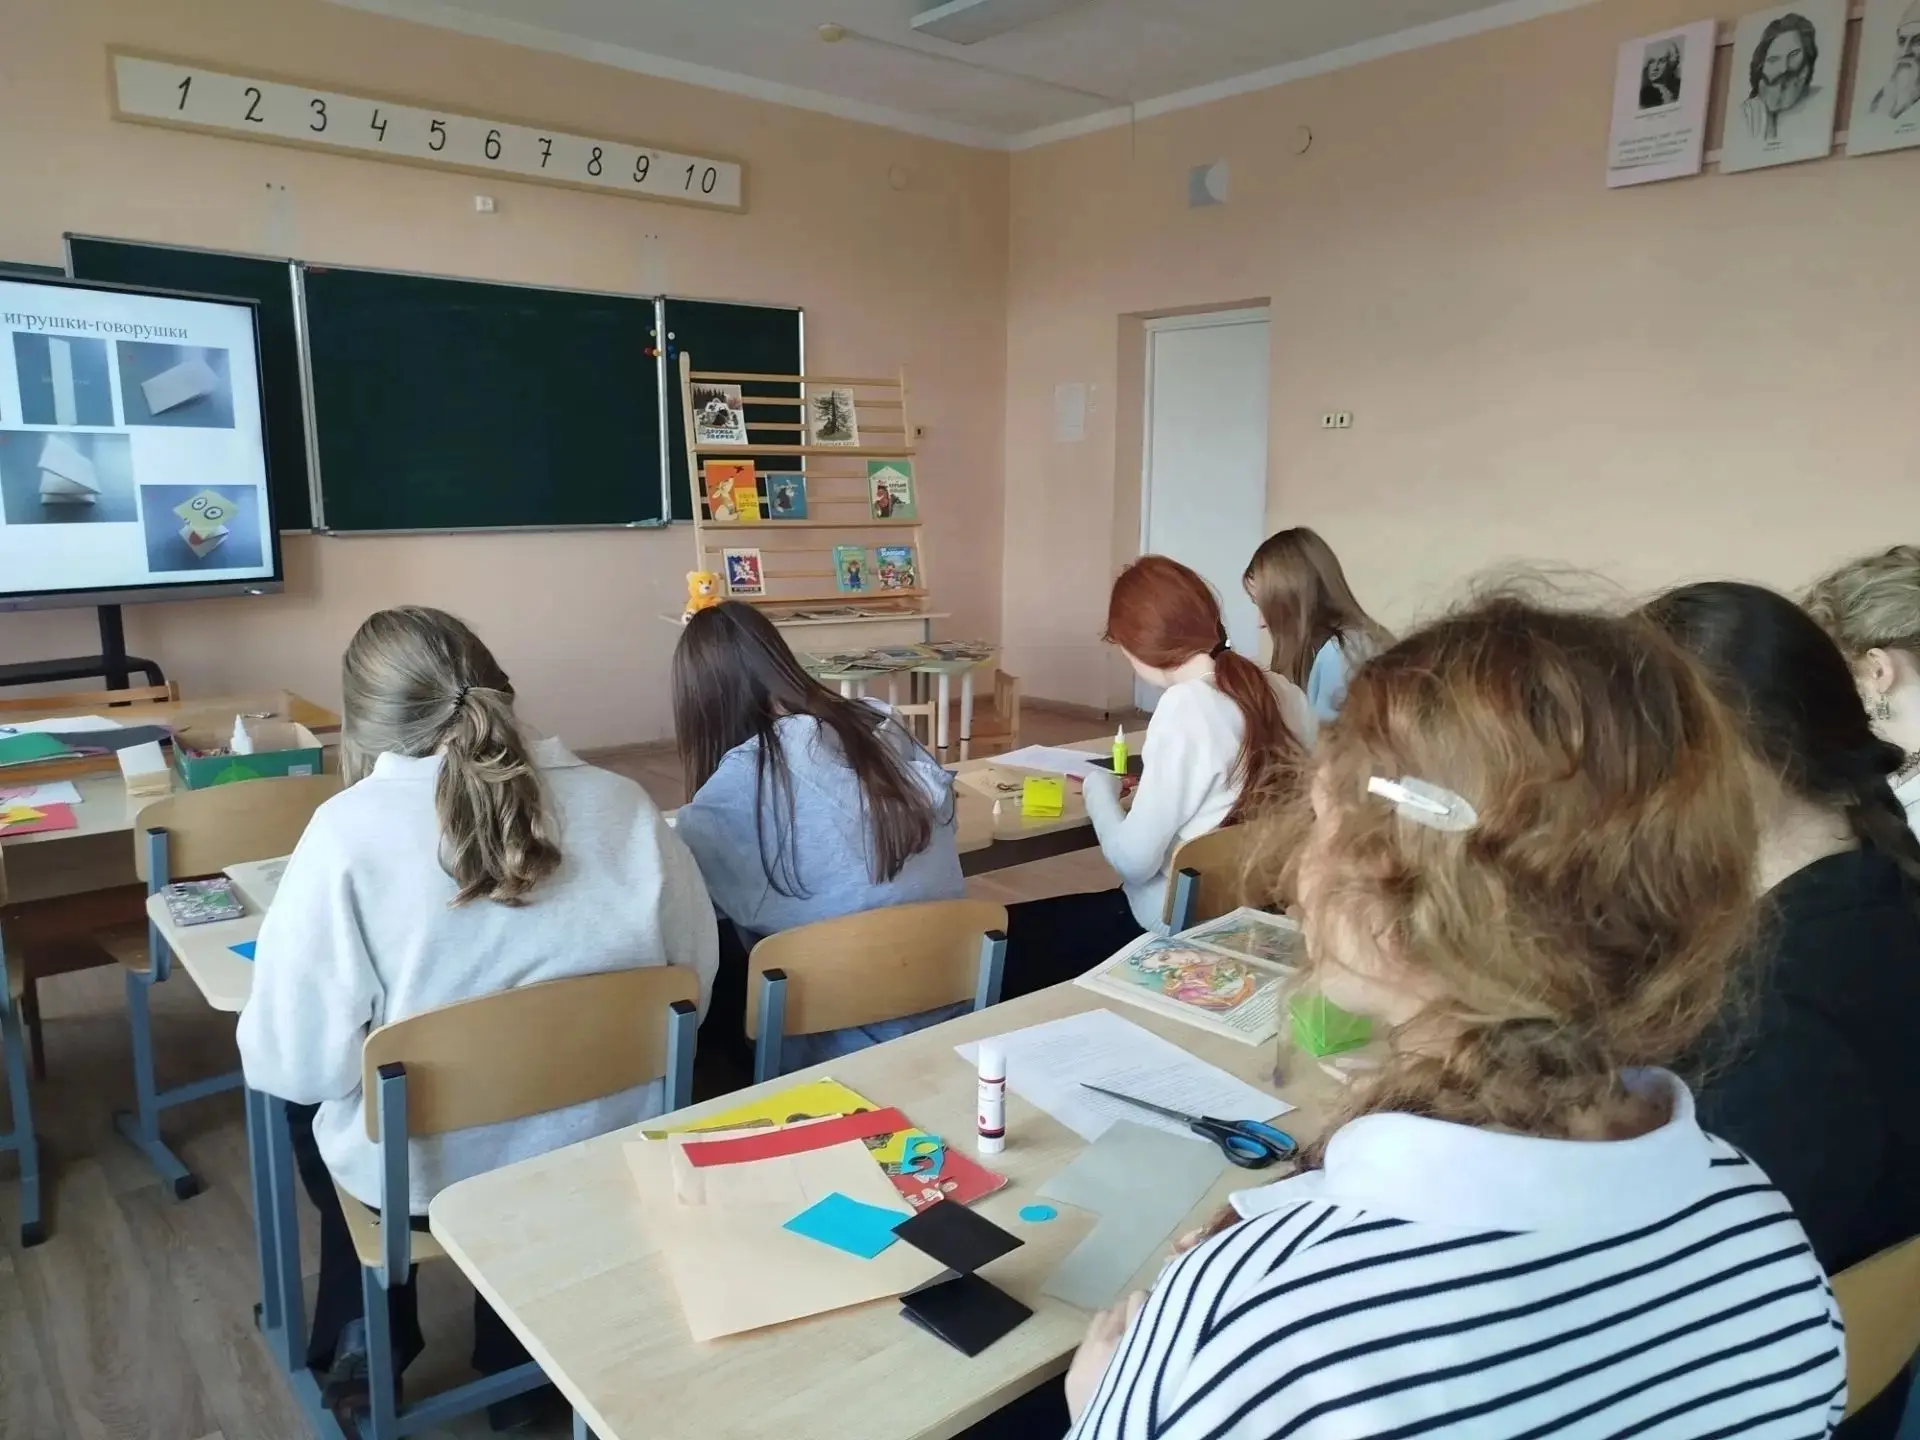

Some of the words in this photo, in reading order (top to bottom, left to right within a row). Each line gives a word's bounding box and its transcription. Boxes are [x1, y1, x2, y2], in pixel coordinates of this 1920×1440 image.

[178, 76, 192, 111] 1
[244, 87, 264, 123] 2
[309, 98, 328, 133] 3
[370, 109, 388, 142] 4
[428, 119, 446, 152] 5
[484, 129, 502, 160] 6
[538, 137, 553, 168] 7
[587, 146, 603, 177] 8
[632, 155, 650, 183] 9
[684, 163, 717, 194] 10
[4, 311, 188, 339] игрушки-говорушки
